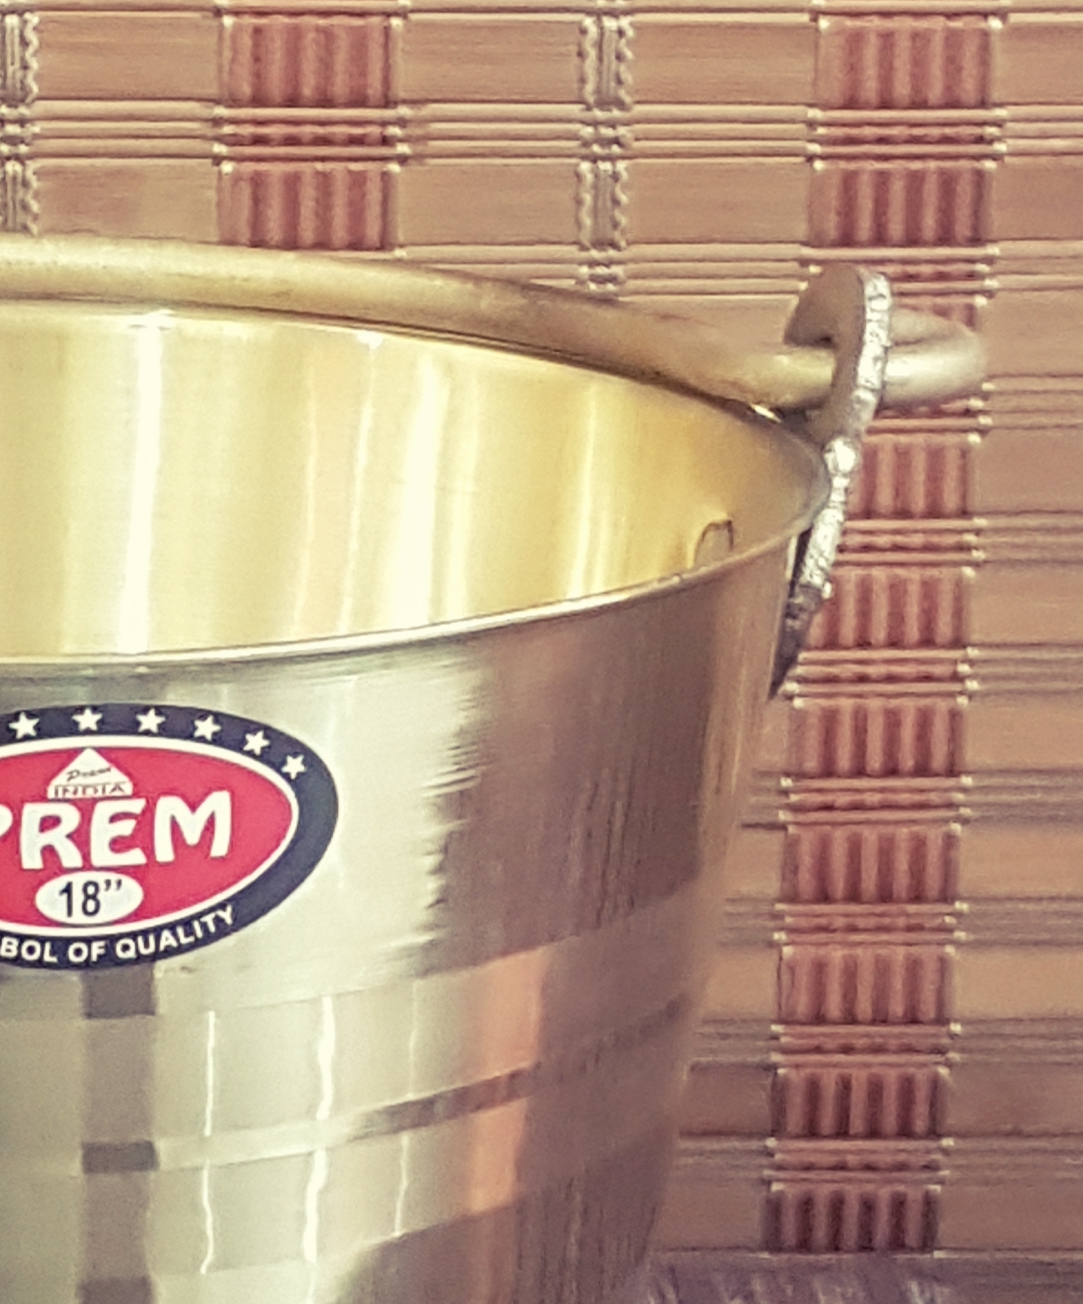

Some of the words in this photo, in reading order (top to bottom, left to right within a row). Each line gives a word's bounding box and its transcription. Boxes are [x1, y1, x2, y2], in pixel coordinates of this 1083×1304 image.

[53, 782, 126, 798] INDIA
[61, 943, 107, 964] OF
[114, 903, 235, 960] QUALITY
